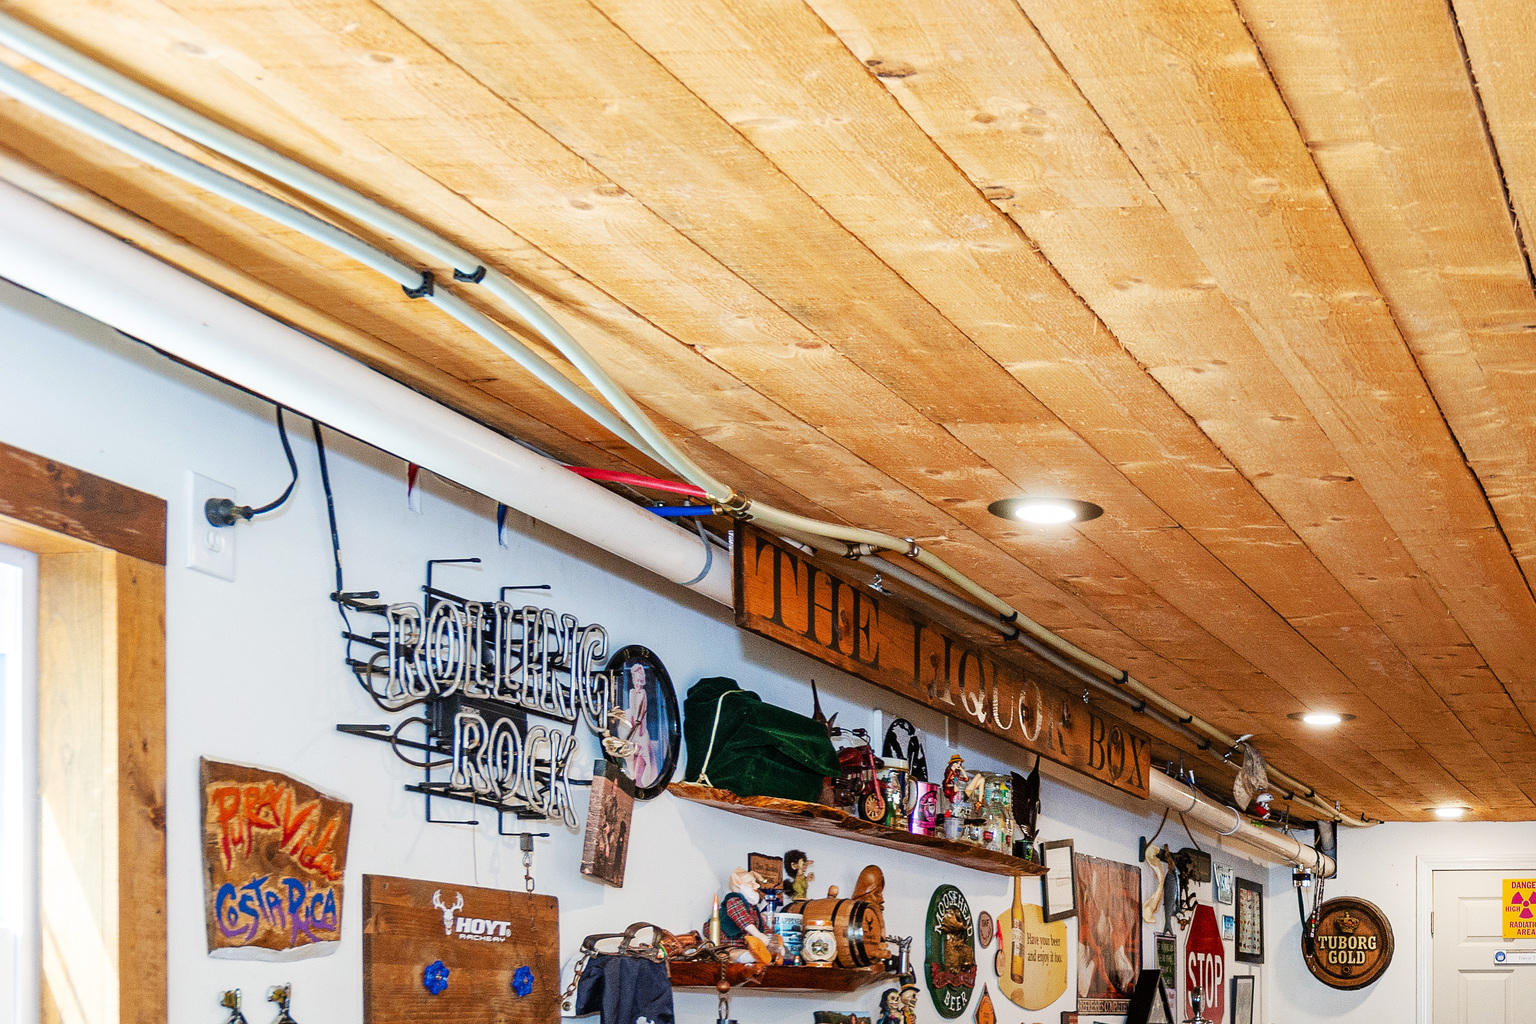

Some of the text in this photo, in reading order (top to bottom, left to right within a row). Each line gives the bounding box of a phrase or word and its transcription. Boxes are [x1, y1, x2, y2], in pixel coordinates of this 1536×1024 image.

[386, 600, 609, 733] ROLLING
[755, 537, 1148, 788] THE LIQUOR BOX
[451, 712, 580, 829] ROCK
[934, 890, 973, 938] MOOSEHEAD
[455, 916, 511, 937] HOYT
[1026, 932, 1039, 945] Have
[1039, 936, 1050, 949] your
[1050, 934, 1061, 946] beer
[1317, 935, 1377, 950] TUBORG
[1027, 950, 1037, 962] and
[1037, 950, 1050, 966] enjoy
[1328, 950, 1366, 964] GOLD
[1188, 951, 1223, 1009] STOP
[943, 990, 968, 1012] BEER
